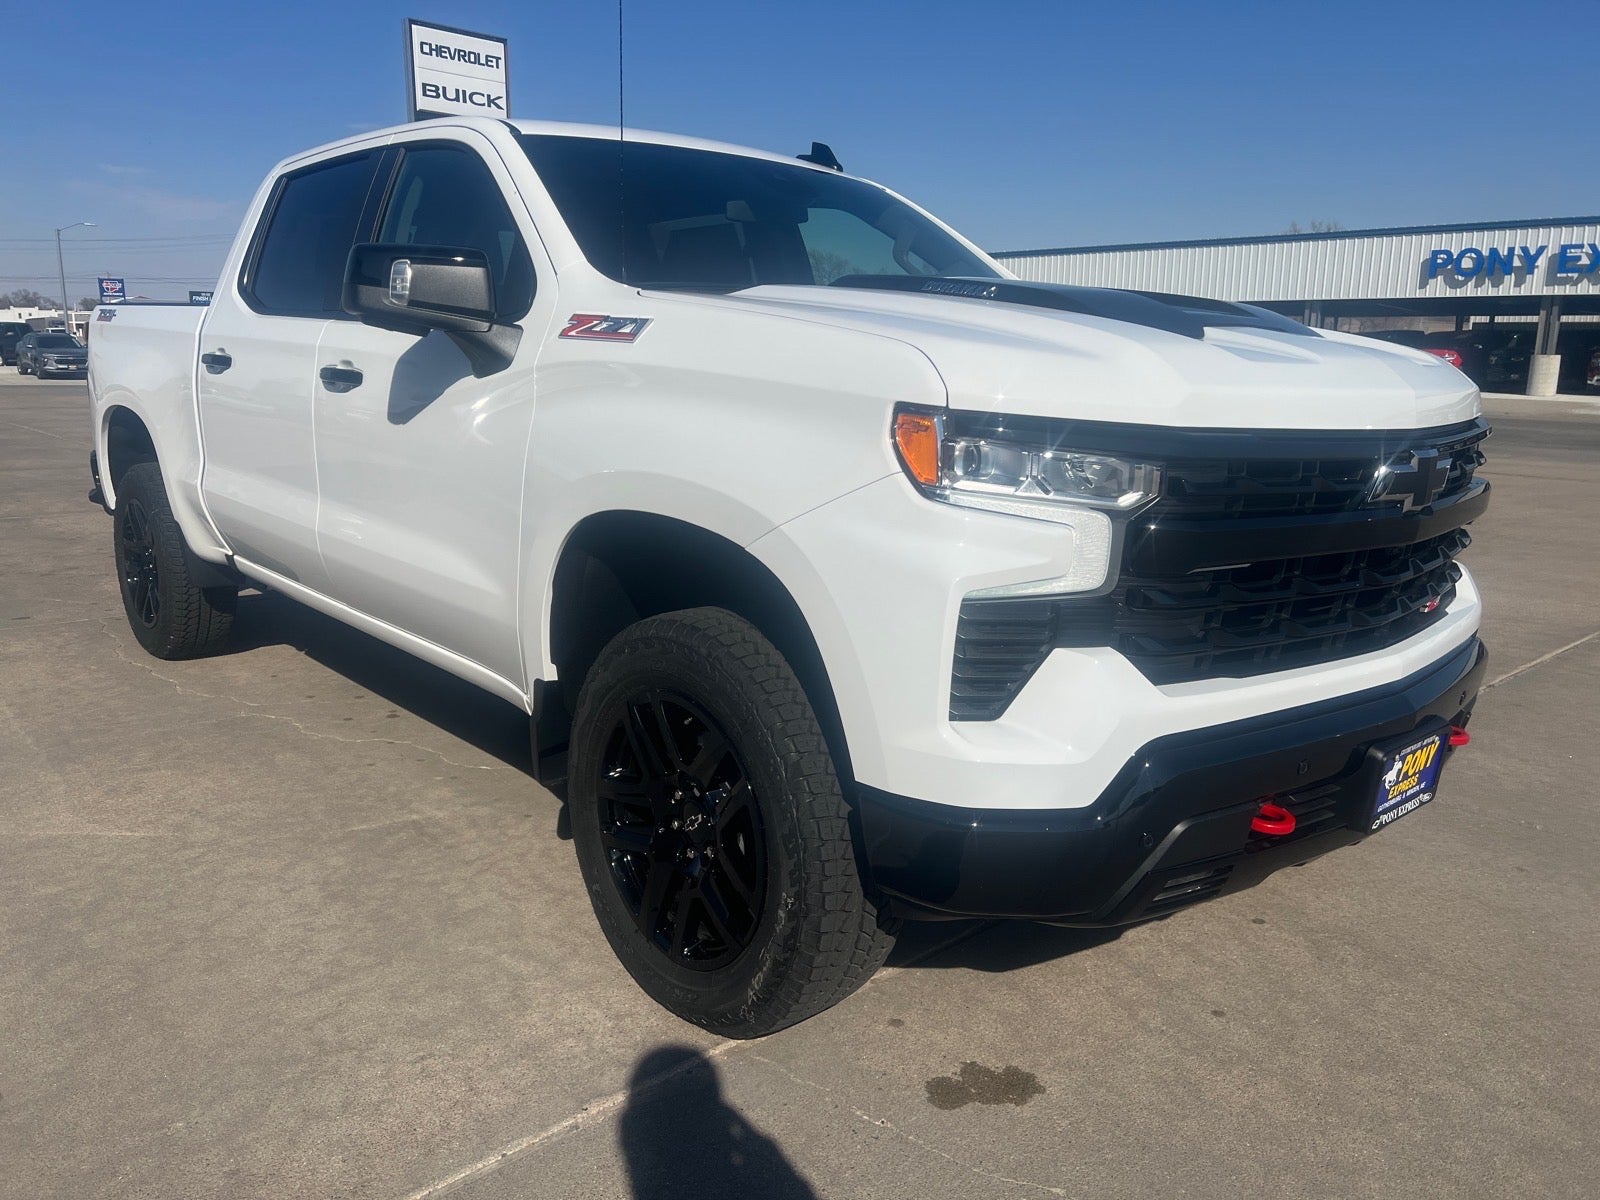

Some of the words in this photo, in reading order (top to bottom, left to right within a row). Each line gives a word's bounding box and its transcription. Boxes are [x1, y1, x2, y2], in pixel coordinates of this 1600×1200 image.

[420, 41, 501, 69] CHEVROLET
[422, 82, 504, 110] BUICK
[1429, 245, 1548, 279] PONY
[1399, 741, 1440, 781] PONY
[1388, 774, 1419, 799] EXPRESS
[1382, 809, 1399, 824] PONY
[1398, 797, 1420, 817] EXPRESS
